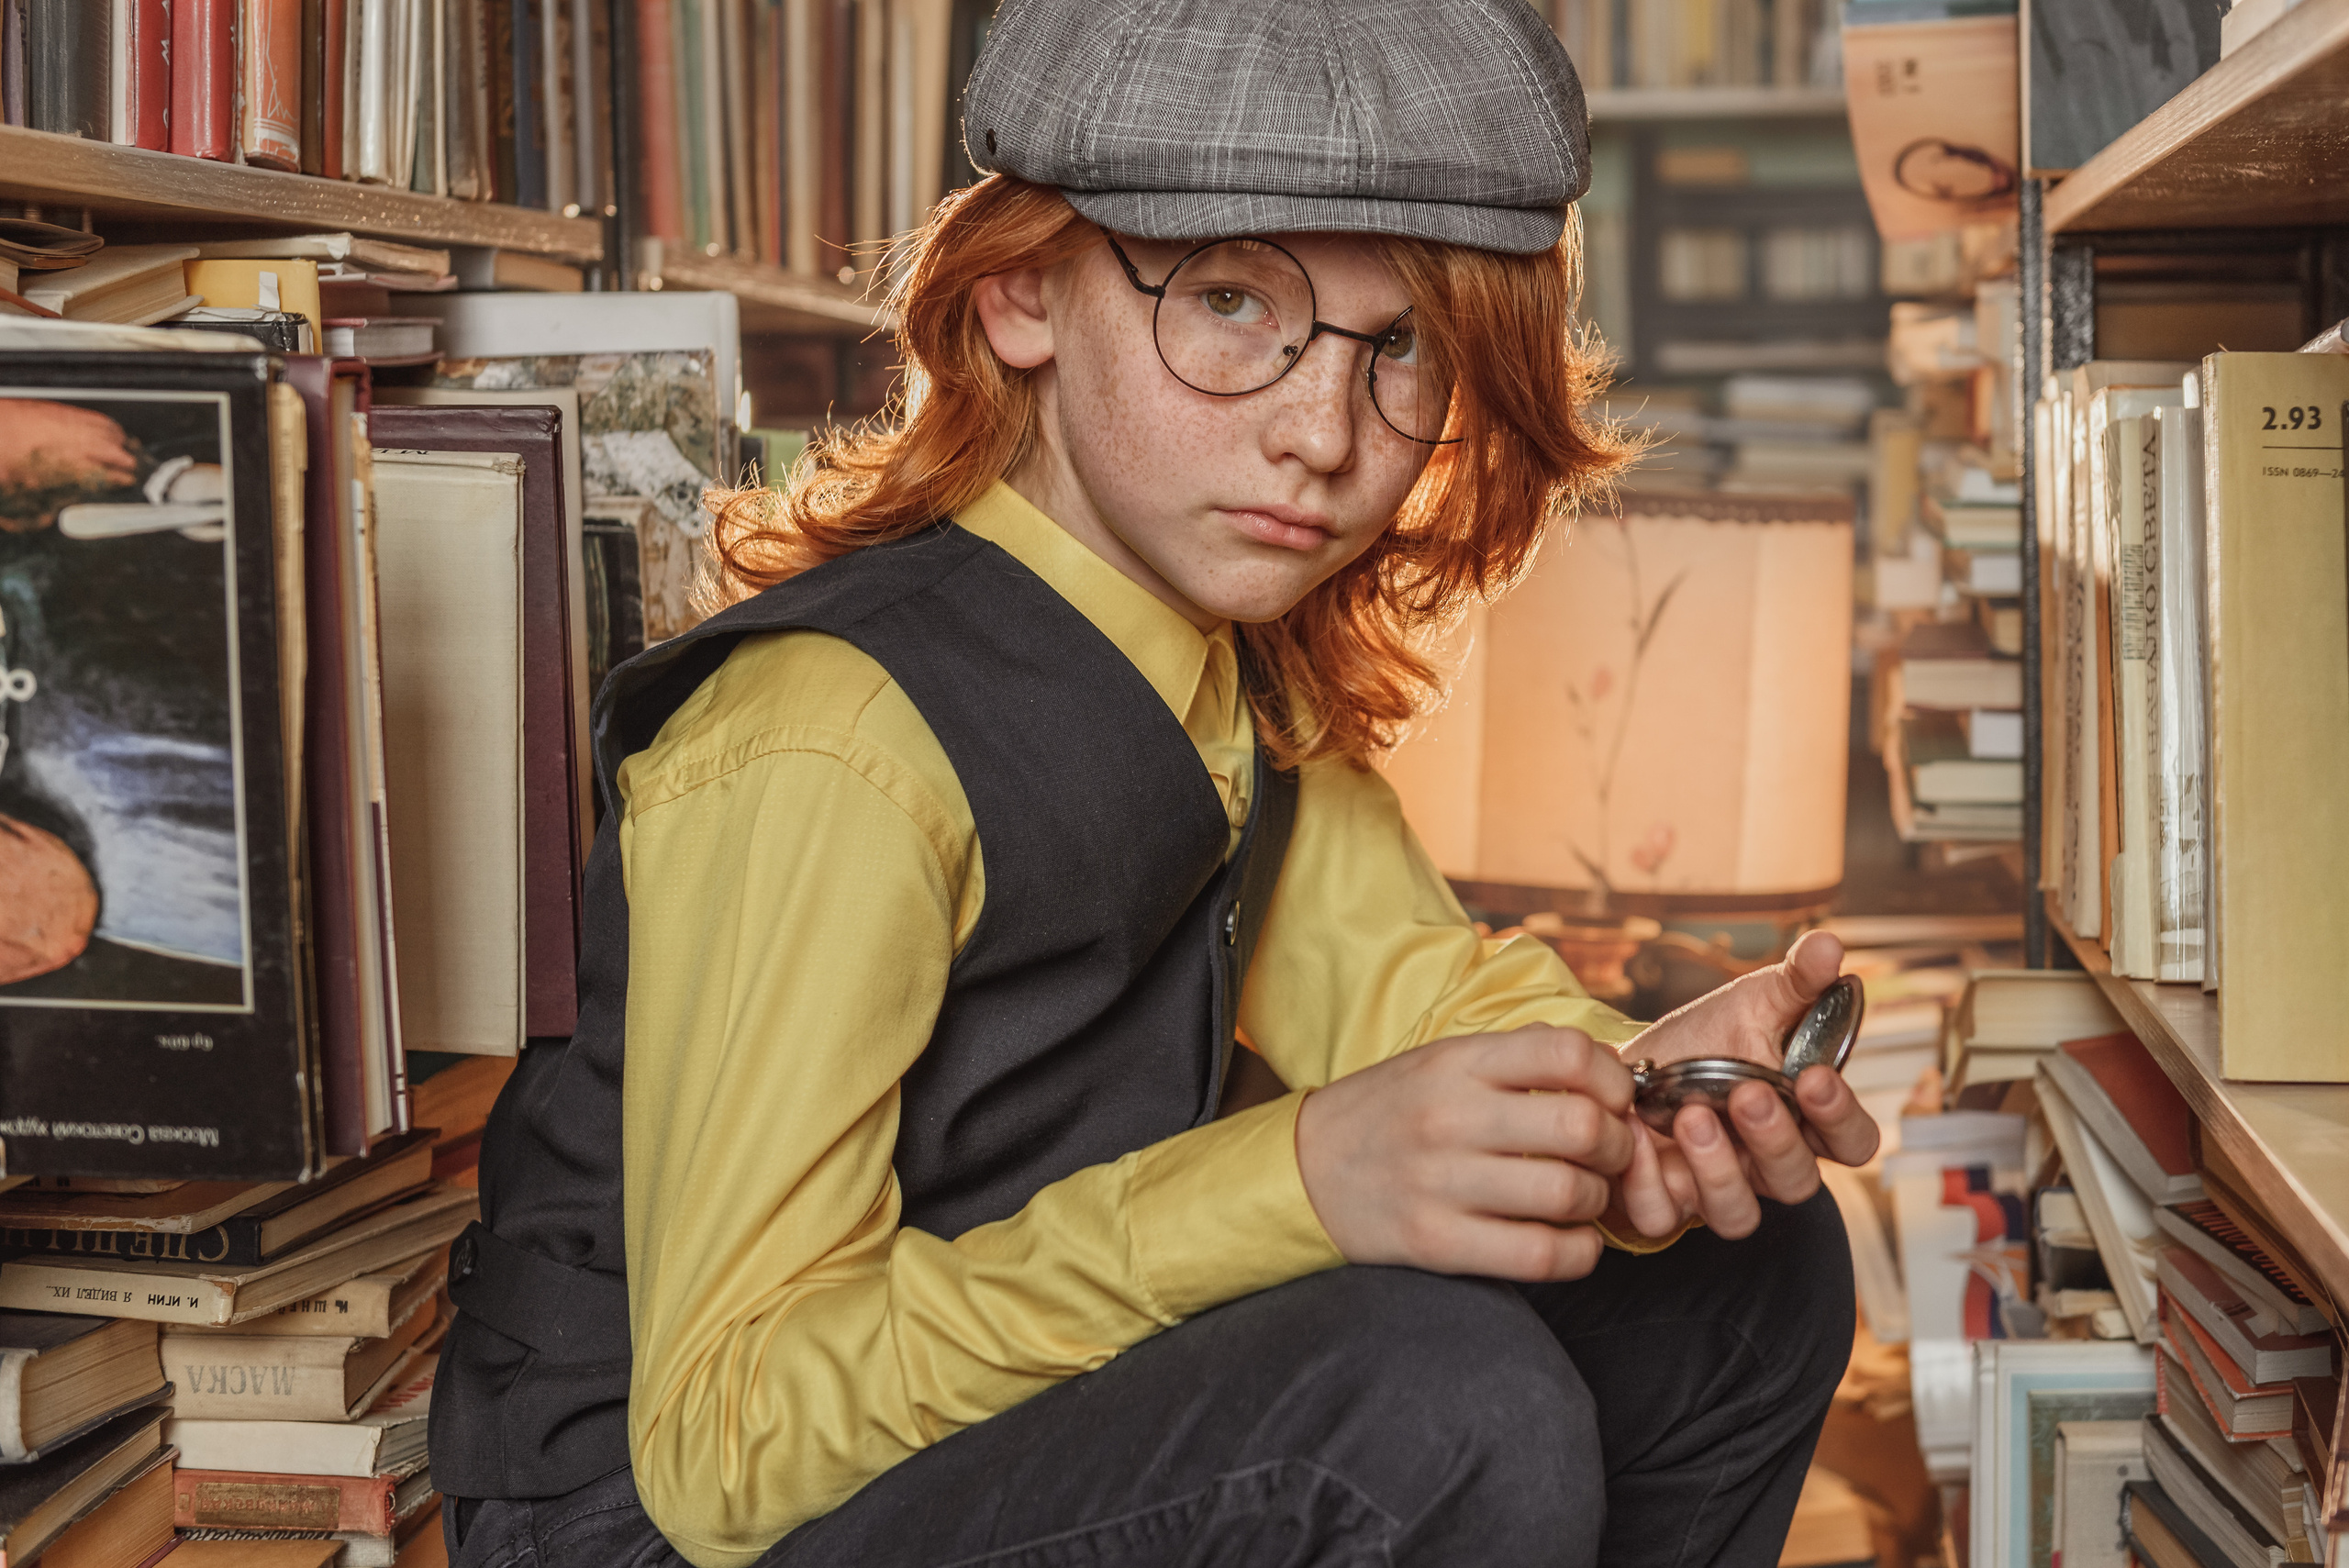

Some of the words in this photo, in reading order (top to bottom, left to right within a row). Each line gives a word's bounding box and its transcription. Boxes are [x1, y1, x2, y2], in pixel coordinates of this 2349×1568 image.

[2262, 406, 2321, 430] 2.93
[2262, 466, 2289, 476] ISSN
[2143, 432, 2157, 575] СВЕТА
[2143, 584, 2157, 756] НАЧАЛО
[51, 1120, 145, 1145] Советский
[148, 1124, 219, 1147] Москва
[75, 1287, 118, 1303] ВИДЕЛ
[123, 1291, 133, 1303] Я
[147, 1294, 181, 1307] ИГИН
[186, 1296, 198, 1308] И.
[184, 1364, 295, 1396] МАСКА
